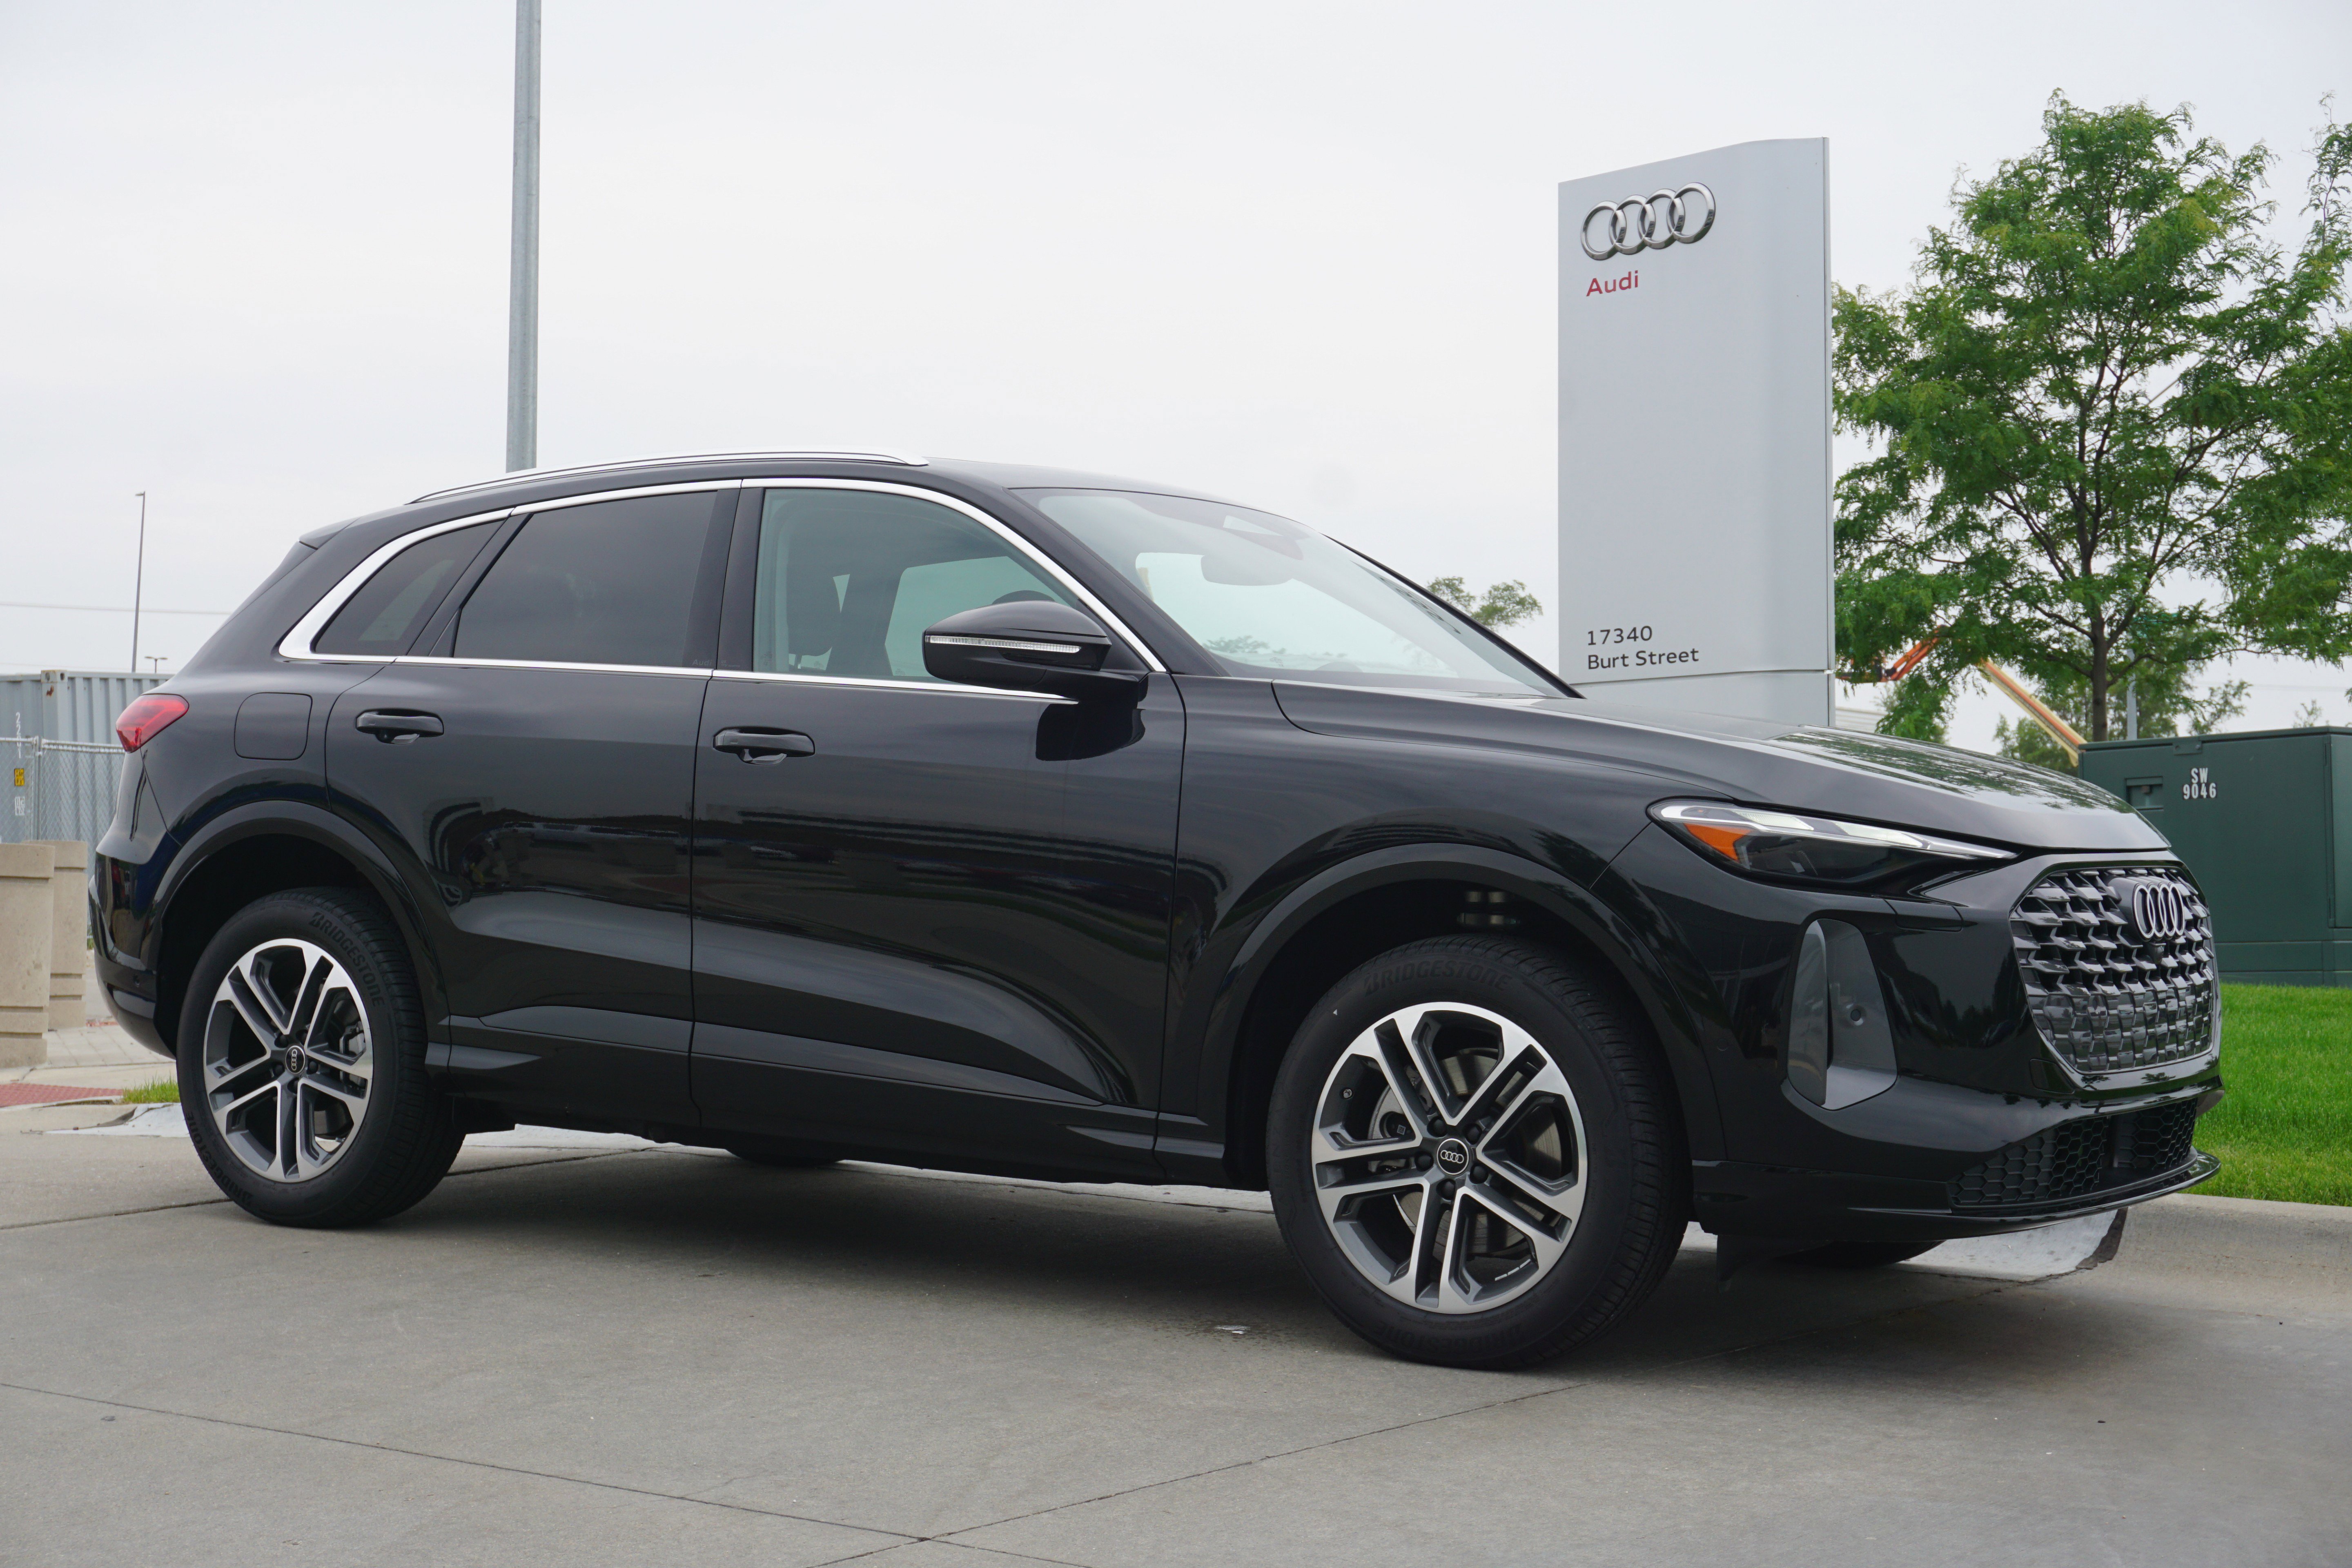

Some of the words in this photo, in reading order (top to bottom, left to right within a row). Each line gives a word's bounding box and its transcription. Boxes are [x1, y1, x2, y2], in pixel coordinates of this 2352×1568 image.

[1586, 270, 1639, 296] Audi
[1588, 626, 1653, 646] 17340
[1588, 654, 1629, 669] Burt
[1636, 648, 1699, 666] Street
[2191, 768, 2208, 783] SW
[2183, 783, 2216, 800] 9046
[309, 911, 385, 1008] BRIDGESTONE
[1363, 959, 1514, 997] BRIDGESTONE
